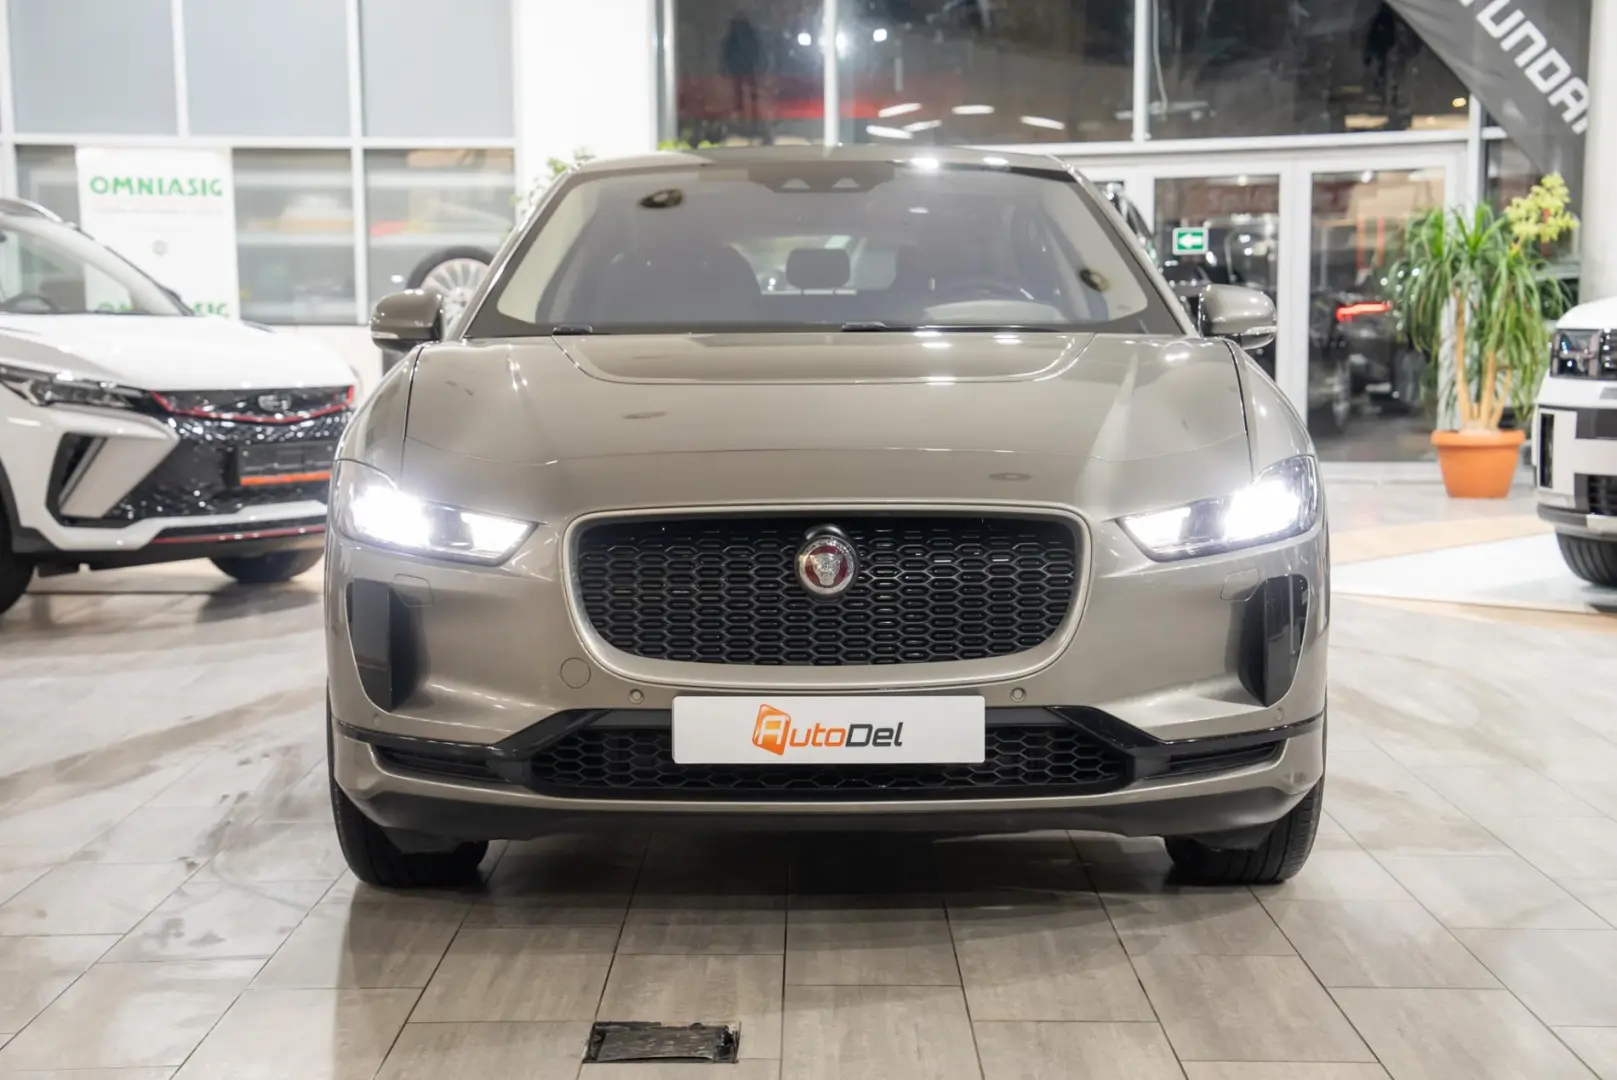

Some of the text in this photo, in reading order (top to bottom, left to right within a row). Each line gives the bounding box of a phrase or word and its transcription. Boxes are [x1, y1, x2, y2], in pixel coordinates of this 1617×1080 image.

[1458, 0, 1590, 135] UNDA
[89, 176, 223, 196] OMNIASIG
[752, 704, 904, 755] AutoDel
